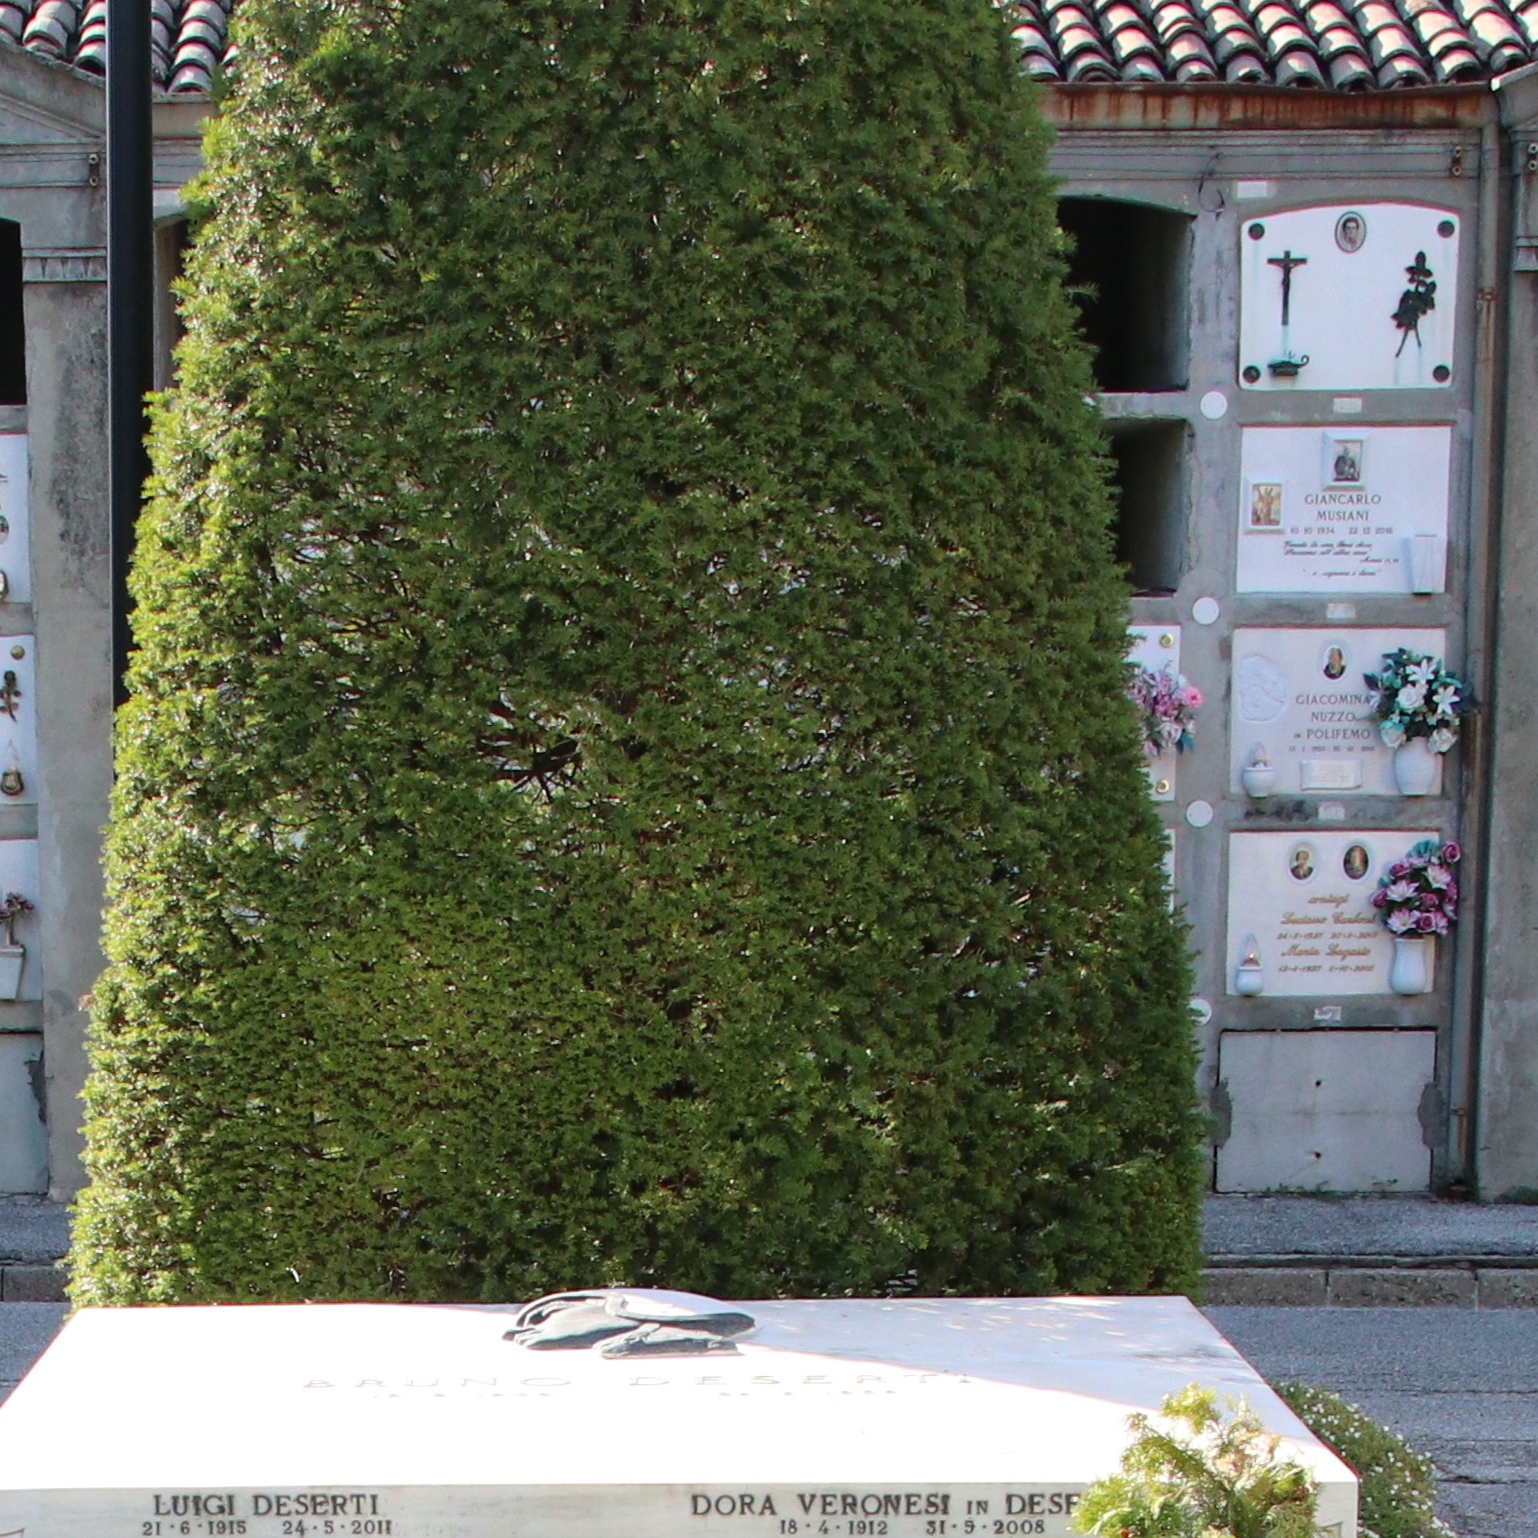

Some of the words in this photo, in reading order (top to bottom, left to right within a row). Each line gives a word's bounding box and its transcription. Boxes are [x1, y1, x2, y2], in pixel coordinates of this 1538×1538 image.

[1304, 494, 1382, 505] GIANCARLO
[1316, 510, 1369, 521] MUSIANI
[1295, 694, 1371, 705] GIACOMINA
[1311, 711, 1356, 722] NUZZO
[1306, 729, 1371, 740] POLIFEMO
[302, 1376, 573, 1388] BRUNO
[628, 1373, 974, 1386] DESERTI
[153, 1493, 236, 1517] LUIGI
[252, 1493, 380, 1517] DESERTI
[690, 1493, 778, 1517] DORA
[796, 1493, 951, 1517] VERONESI
